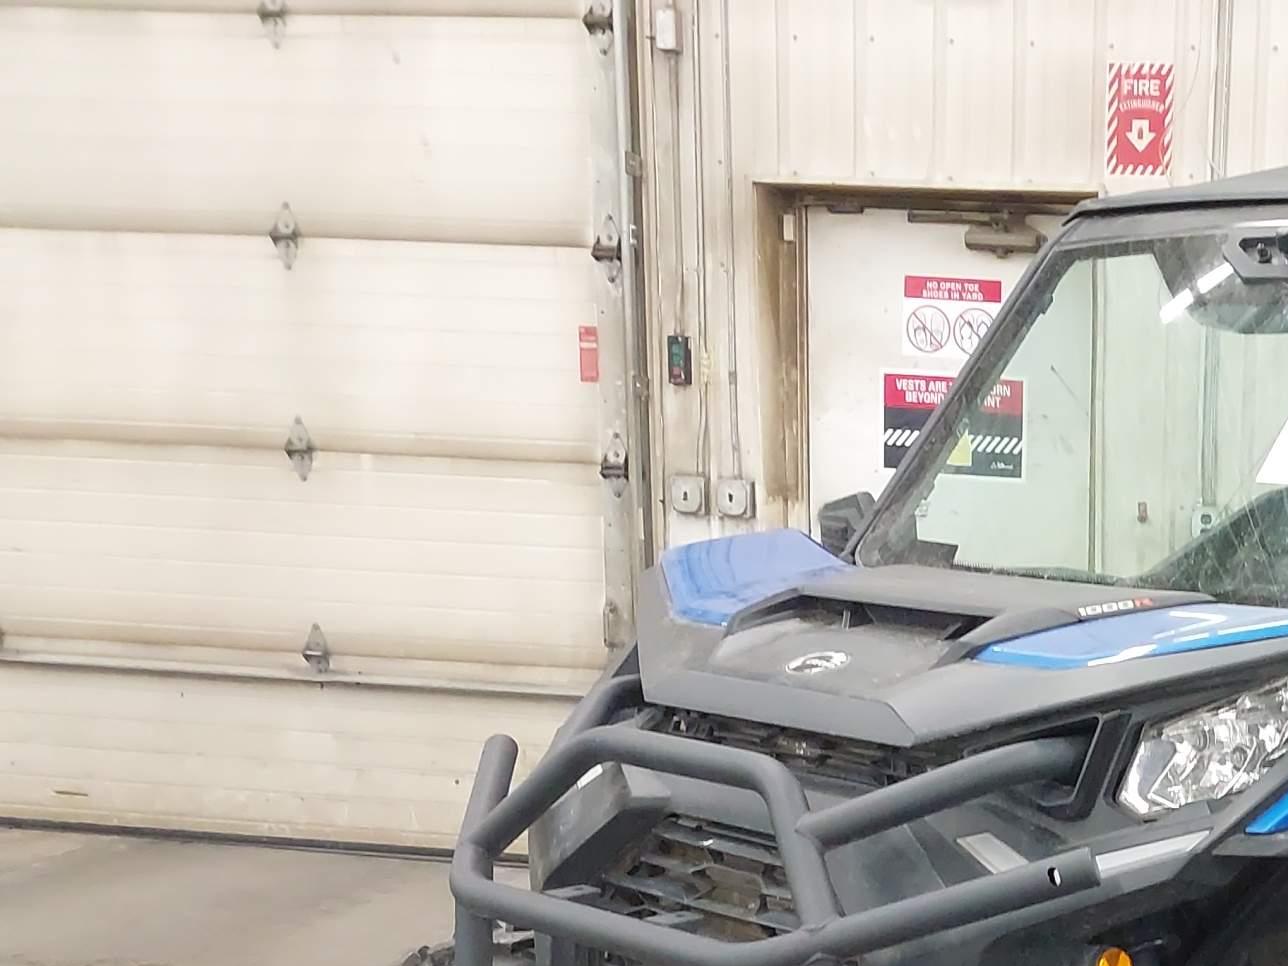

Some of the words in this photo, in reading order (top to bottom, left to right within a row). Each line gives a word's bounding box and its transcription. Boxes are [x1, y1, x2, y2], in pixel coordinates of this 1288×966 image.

[1123, 79, 1161, 97] FIRE
[926, 280, 939, 291] NO
[940, 281, 962, 292] OPEN
[964, 283, 980, 293] TOE
[922, 289, 949, 300] SHOES
[950, 290, 960, 301] IN
[961, 291, 984, 302] YARD
[895, 378, 928, 392] VESTS
[928, 380, 948, 394] ARE
[1078, 597, 1152, 617] 1000R
